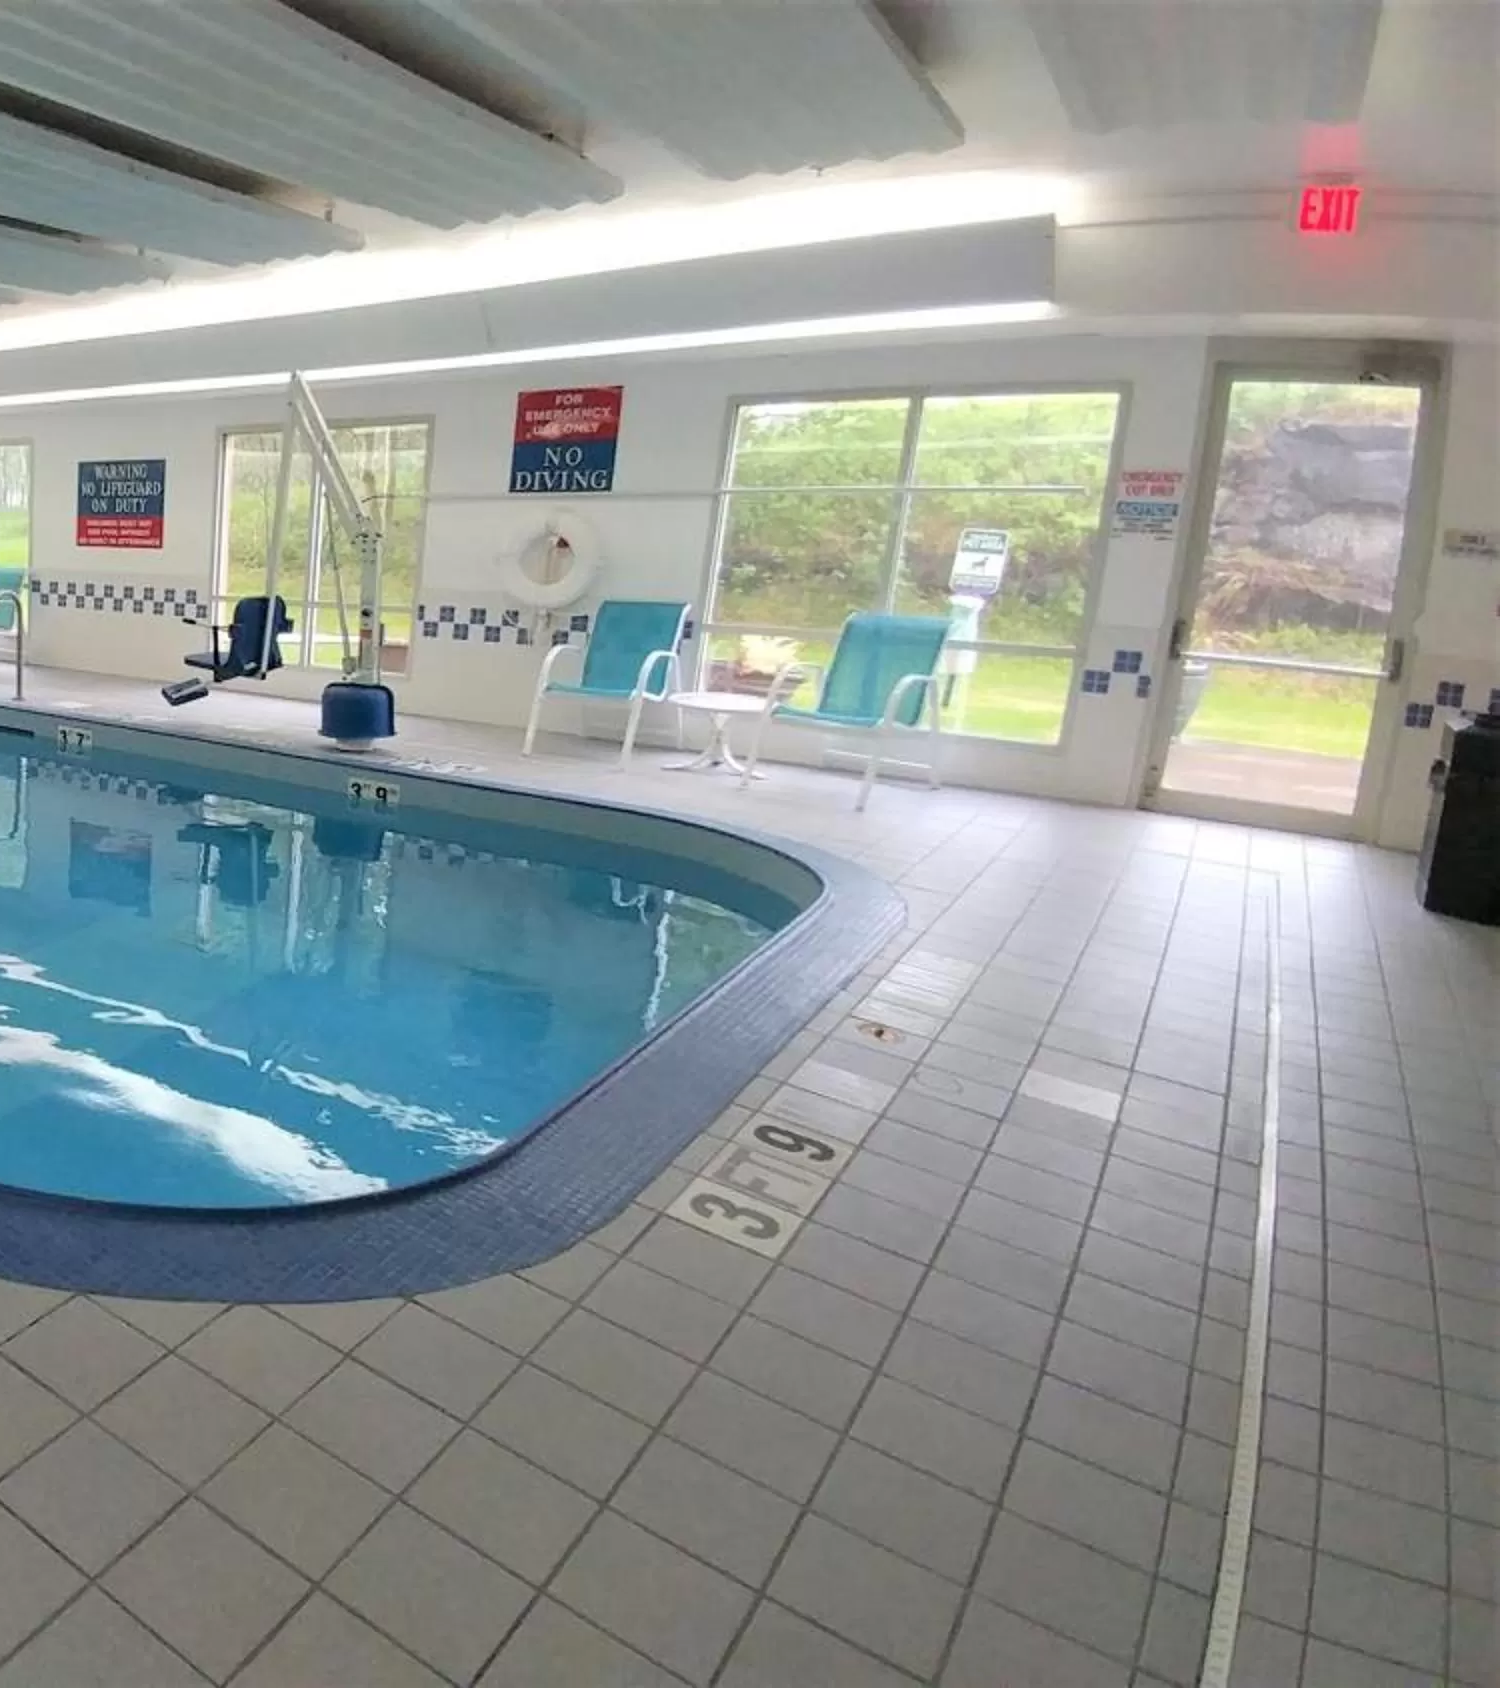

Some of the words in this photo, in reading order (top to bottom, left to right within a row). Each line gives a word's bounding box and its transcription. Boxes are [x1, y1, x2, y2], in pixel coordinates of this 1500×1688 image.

[1300, 187, 1360, 232] EXIT
[555, 394, 583, 405] FOR
[525, 406, 612, 422] EMERGENCY
[563, 421, 599, 433] ONLY
[543, 446, 583, 467] NO
[94, 463, 149, 480] WARNING
[515, 469, 608, 491] DIVING
[82, 482, 96, 497] NO
[101, 481, 161, 497] LIFEGUARD
[91, 498, 107, 513] ON
[115, 498, 148, 513] DUTY
[753, 1125, 836, 1162] 9
[711, 1147, 817, 1210] FT
[689, 1193, 781, 1240] 3
